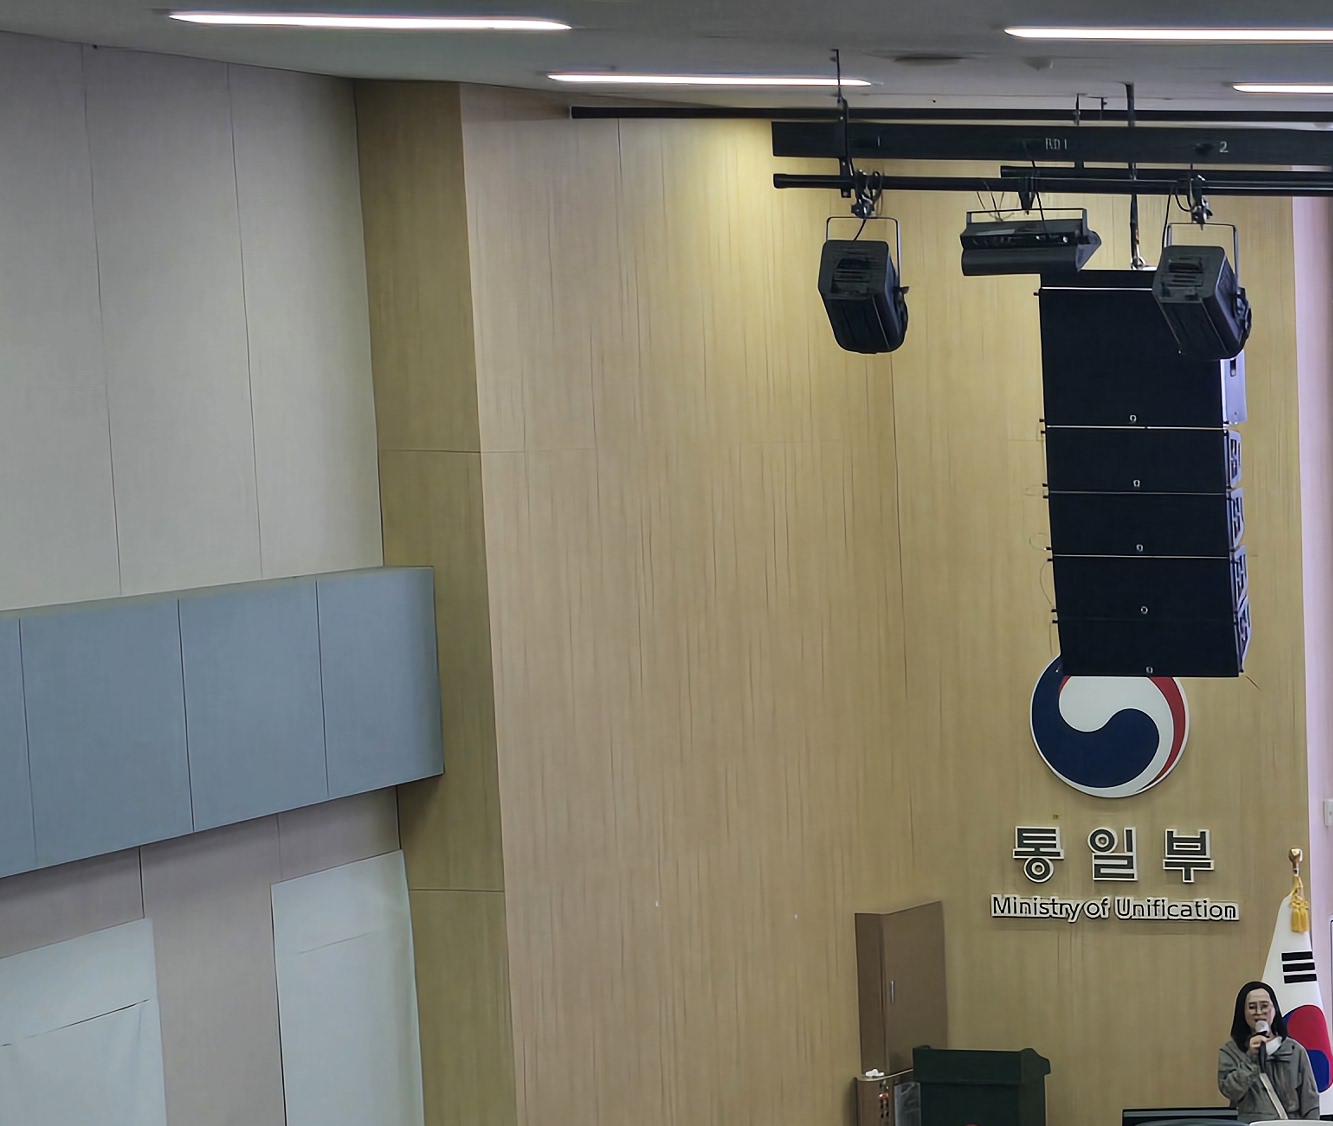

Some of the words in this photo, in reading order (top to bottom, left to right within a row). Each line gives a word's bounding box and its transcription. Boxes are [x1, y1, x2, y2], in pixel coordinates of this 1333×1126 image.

[1219, 141, 1229, 153] 2
[1013, 826, 1214, 883] 통일부
[991, 894, 1080, 923] Ministry
[1084, 895, 1110, 918] of
[1115, 896, 1239, 920] Unification
